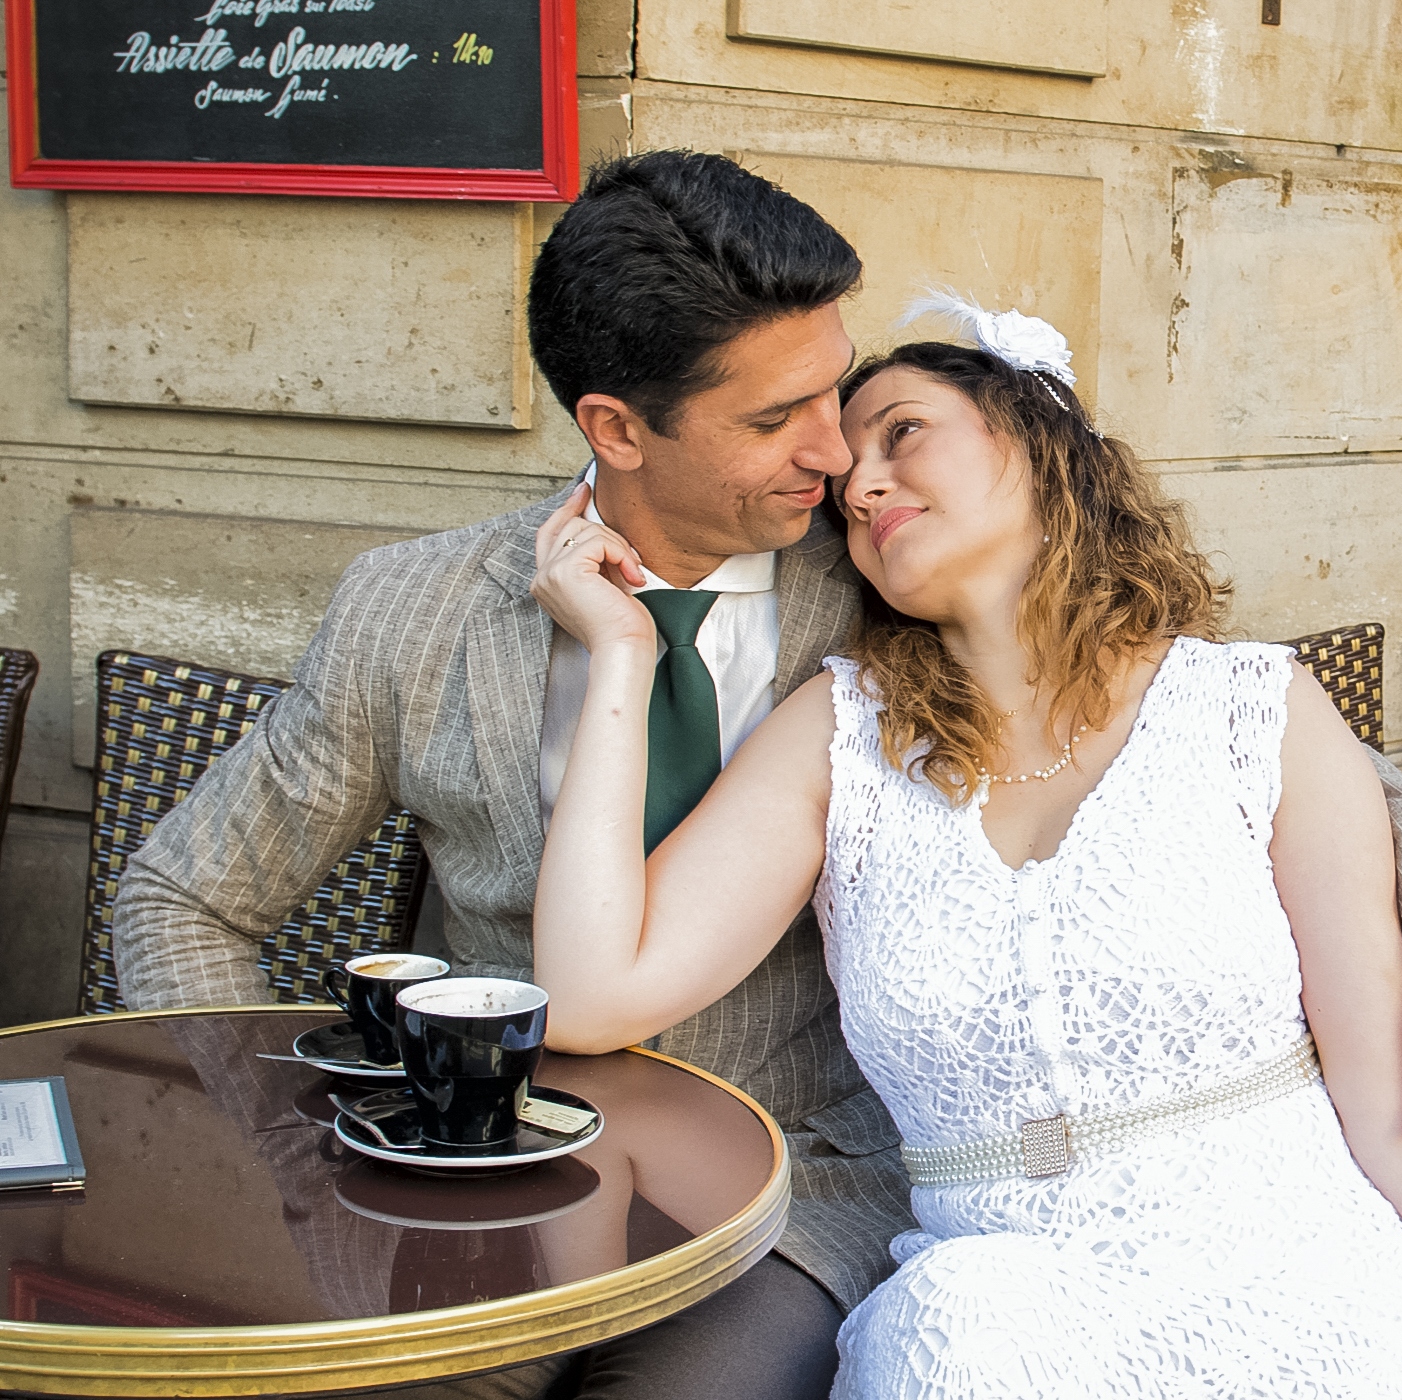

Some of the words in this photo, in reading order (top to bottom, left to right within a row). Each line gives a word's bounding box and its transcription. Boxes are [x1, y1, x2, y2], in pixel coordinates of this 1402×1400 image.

[304, 0, 327, 13] sur
[113, 27, 236, 74] Assiette
[238, 46, 266, 69] de
[268, 26, 418, 78] Saumon
[194, 80, 272, 109] Saumon
